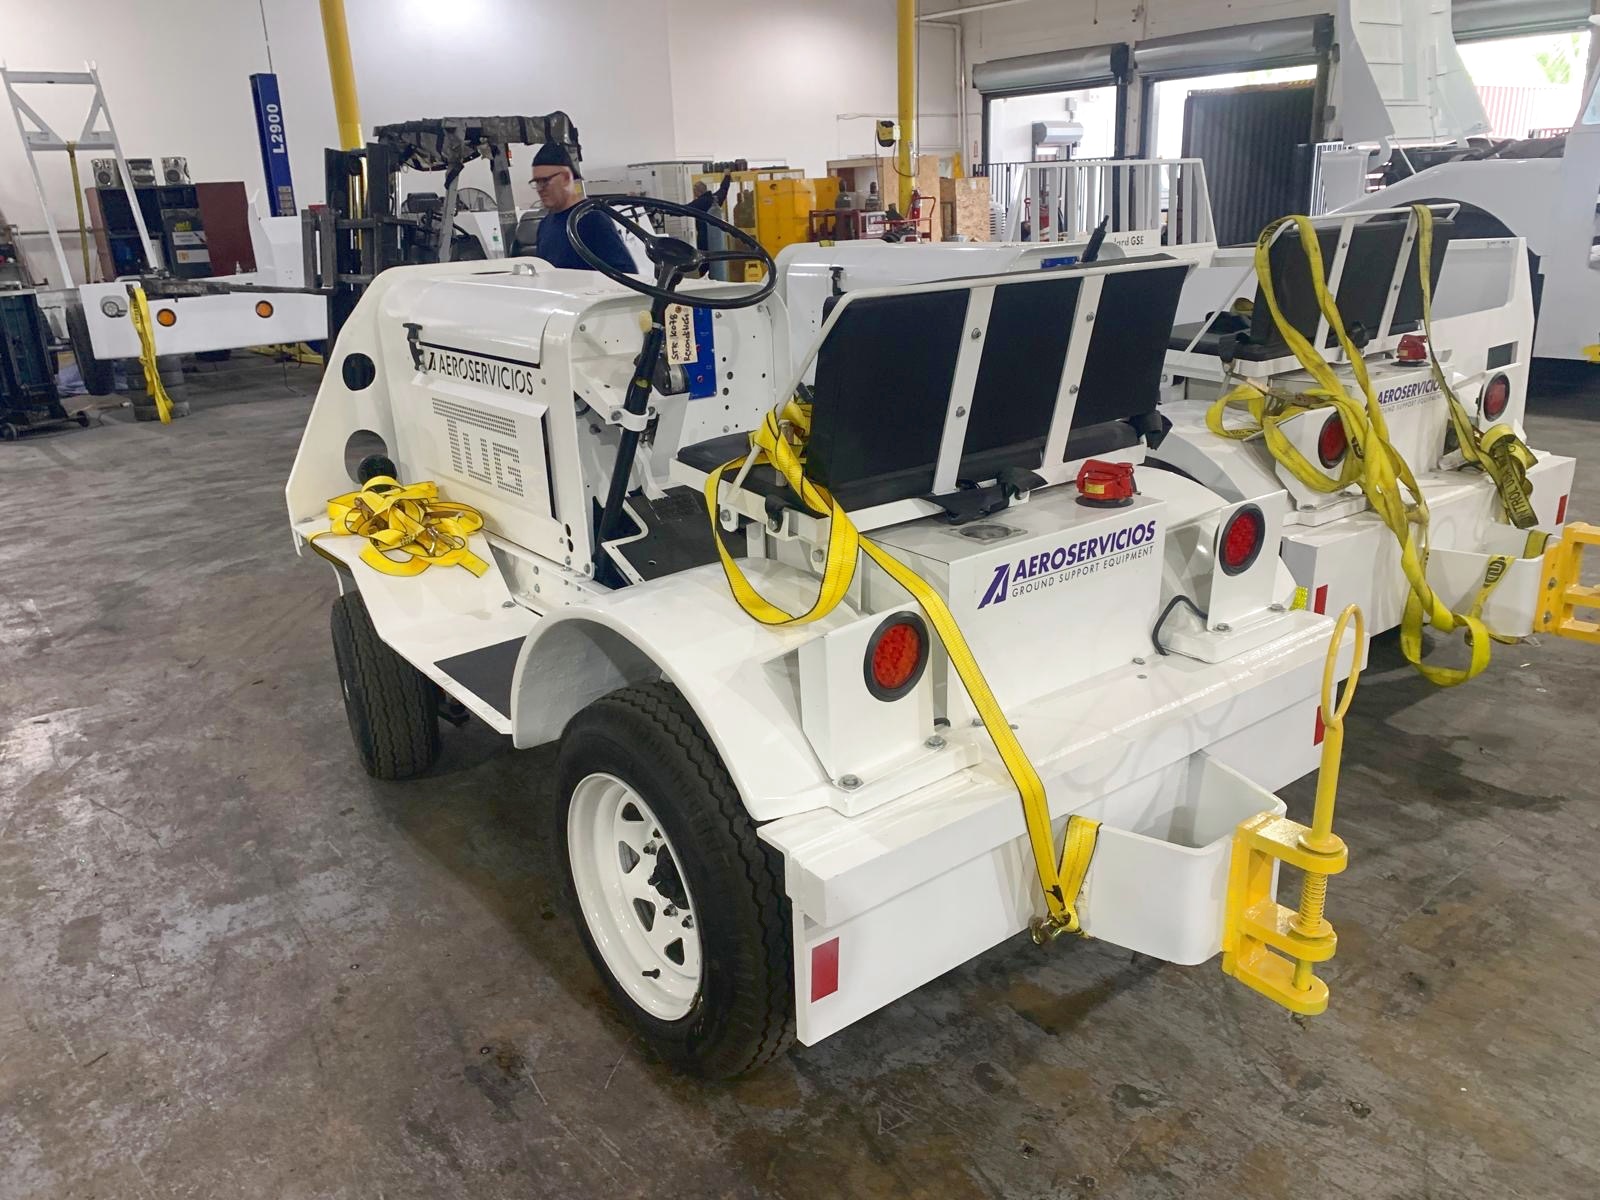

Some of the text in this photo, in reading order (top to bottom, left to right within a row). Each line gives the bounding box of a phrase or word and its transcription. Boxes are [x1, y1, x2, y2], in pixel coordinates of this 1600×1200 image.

[266, 104, 285, 153] L2900
[1131, 235, 1144, 246] GSE
[439, 354, 533, 395] AEROSERVICIOS
[1377, 378, 1442, 405] AEROSERVICIO
[431, 397, 525, 498] TUG
[1011, 545, 1155, 599] GROUND SUPPORT EQUIPMENT
[1012, 520, 1156, 582] AEROSERVICIOS
